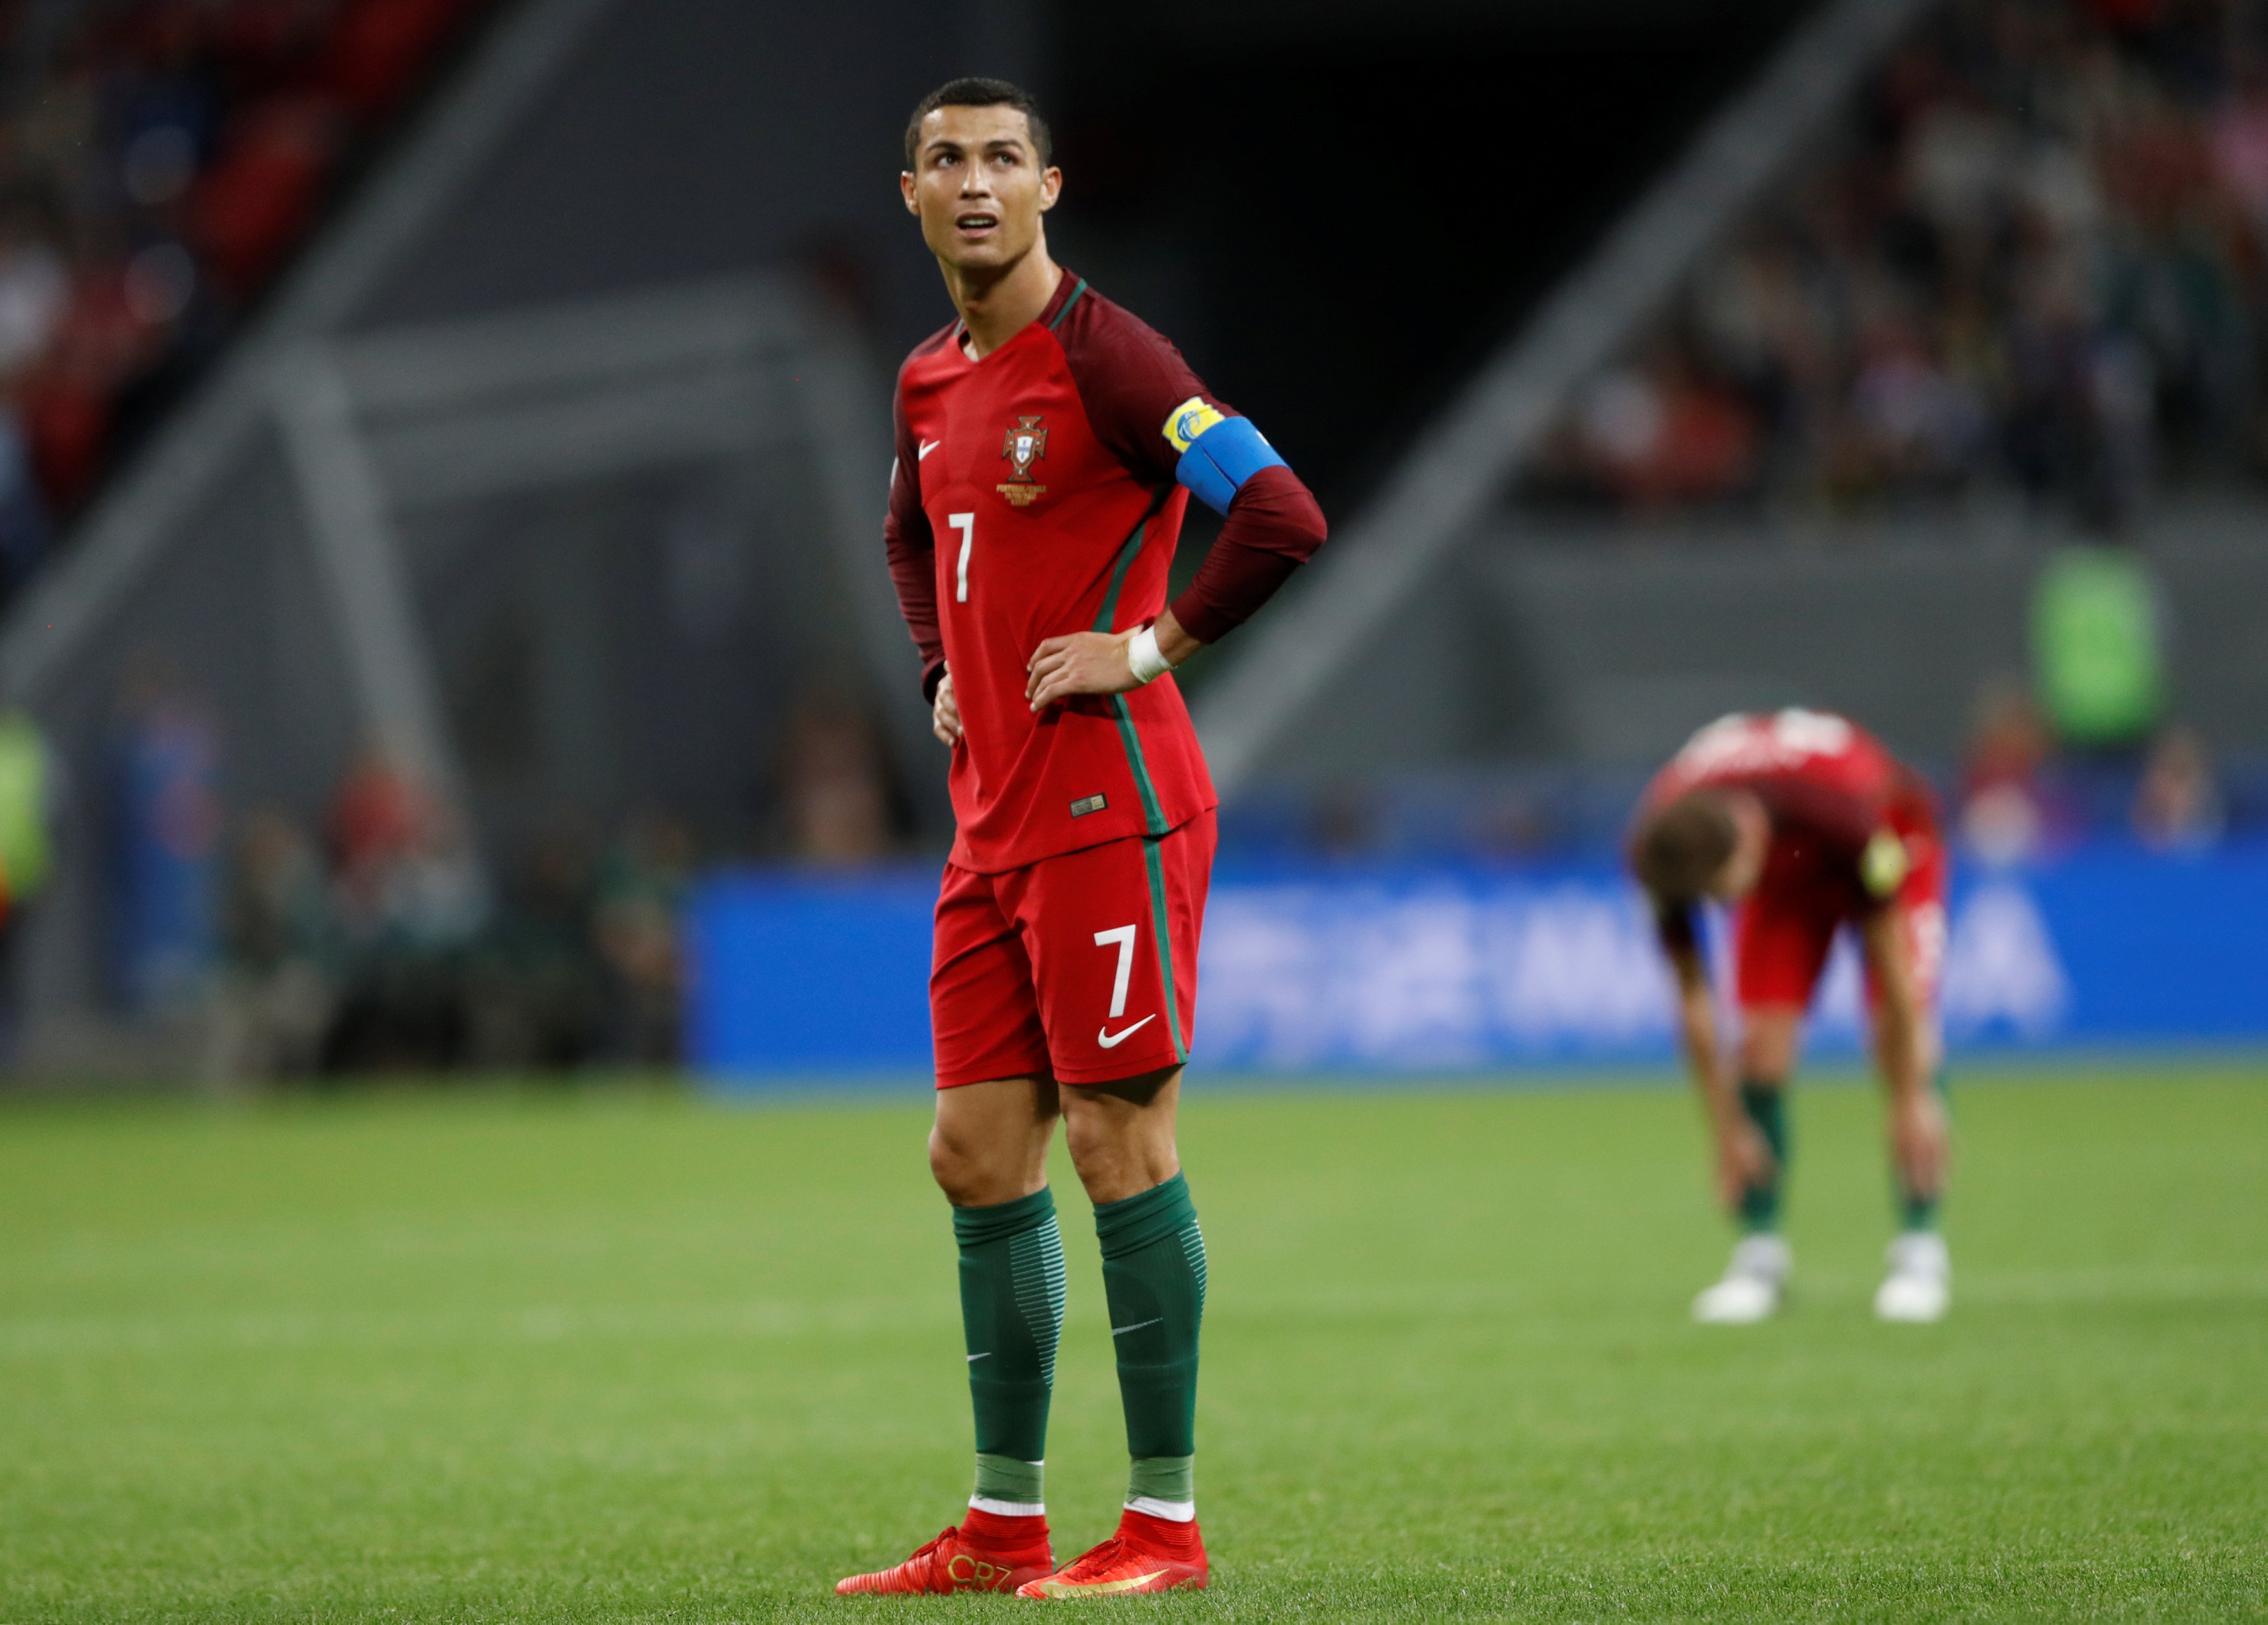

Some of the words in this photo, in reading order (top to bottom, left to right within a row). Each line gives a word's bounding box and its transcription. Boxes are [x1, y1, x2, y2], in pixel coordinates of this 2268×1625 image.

[949, 513, 974, 602] 7
[1094, 924, 1136, 1017] 7
[948, 1554, 1012, 1590] CR7
